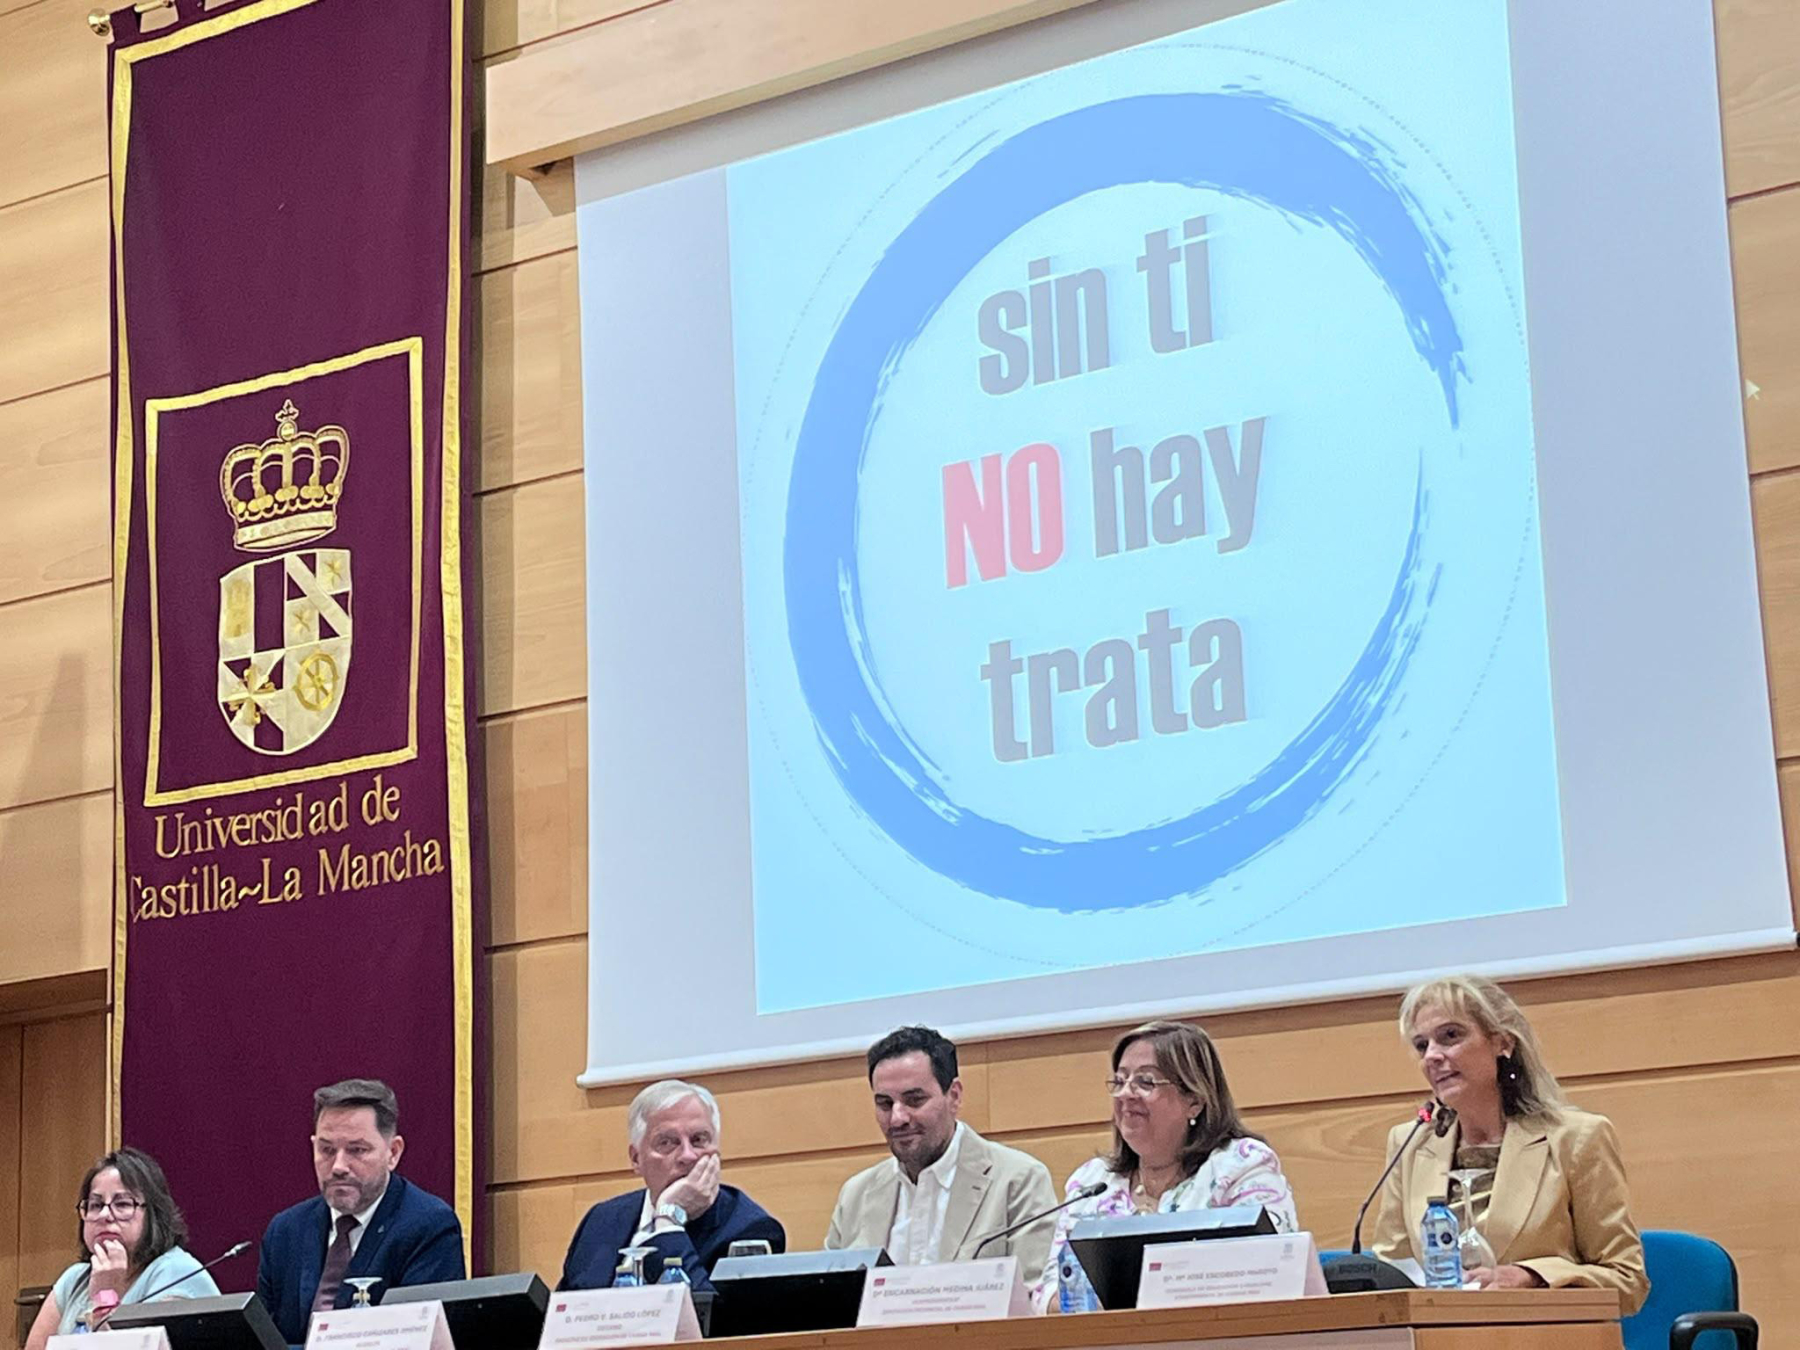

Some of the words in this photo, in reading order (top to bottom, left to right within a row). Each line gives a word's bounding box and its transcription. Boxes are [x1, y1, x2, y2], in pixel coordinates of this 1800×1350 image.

[977, 256, 1111, 395] sin
[1136, 214, 1215, 355] ti
[941, 442, 1065, 589] NO
[1090, 416, 1267, 555] hay
[980, 608, 1248, 763] trata
[154, 780, 349, 859] Universidad
[361, 773, 401, 826] de
[316, 830, 445, 896] Mancha
